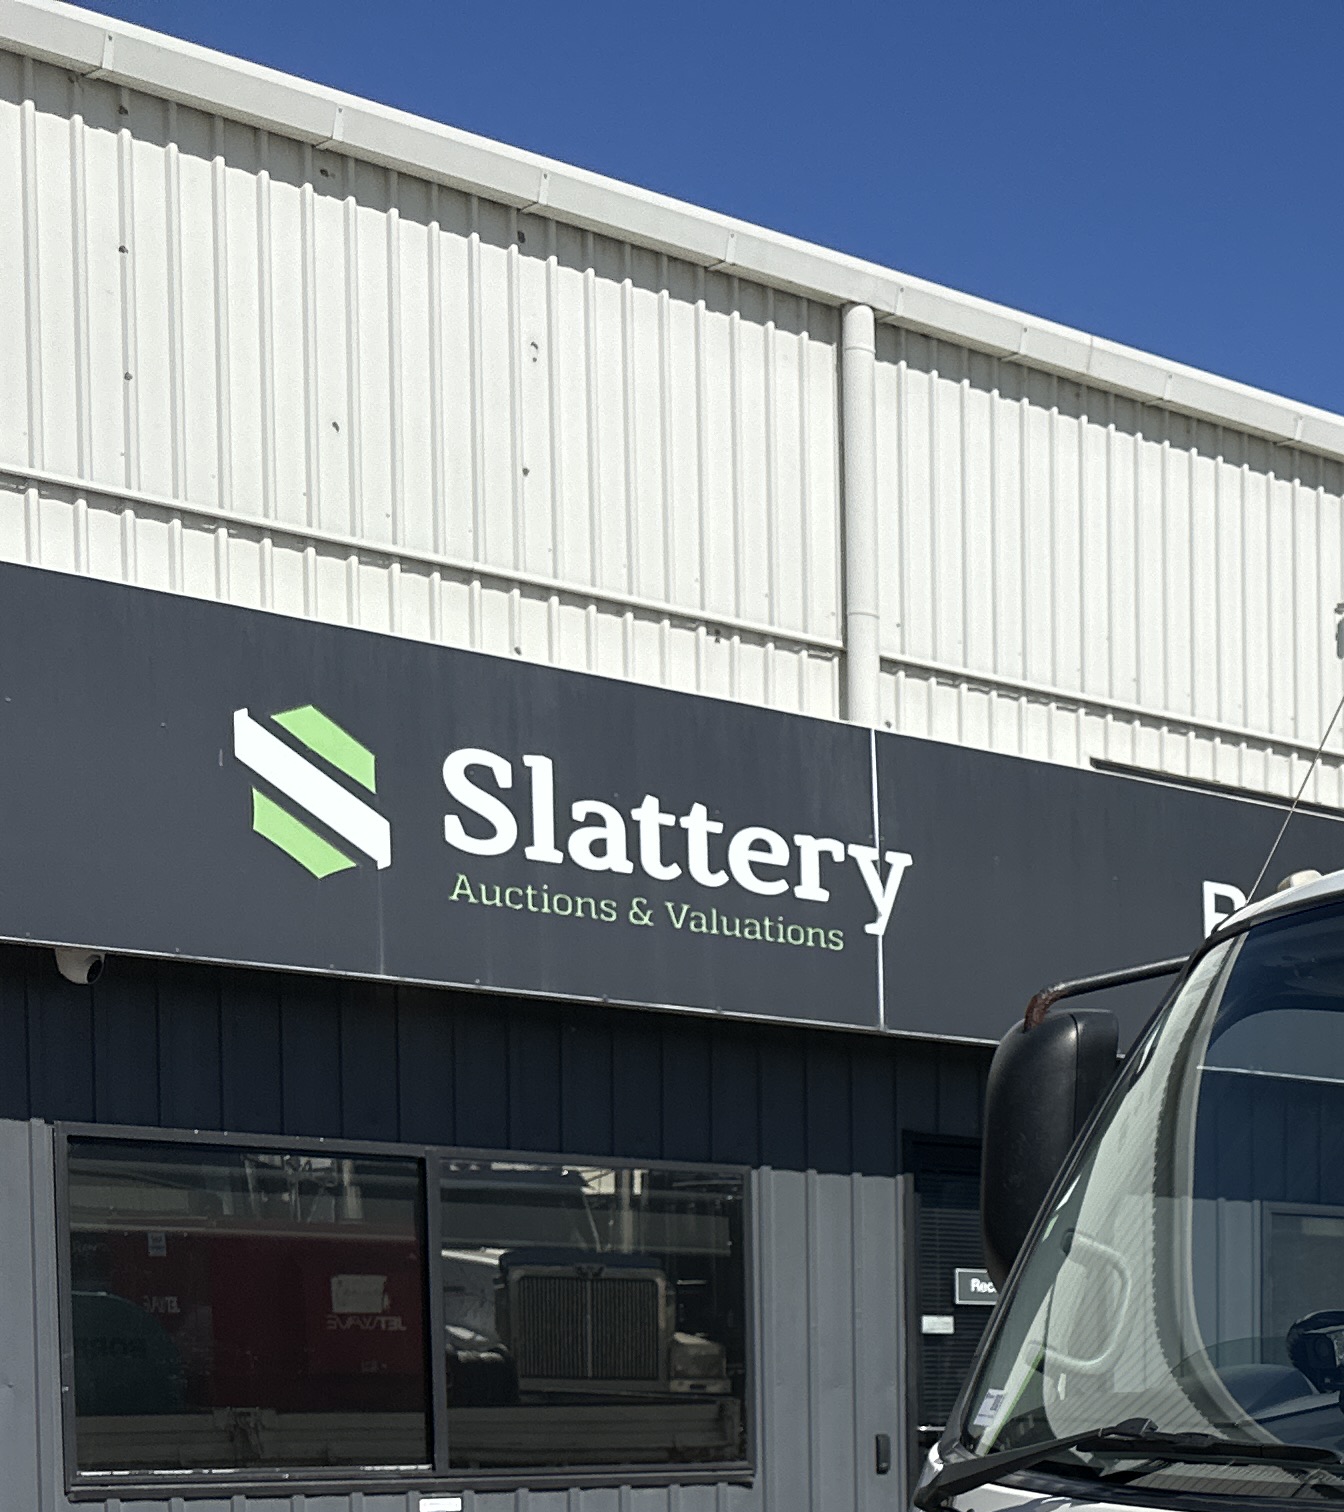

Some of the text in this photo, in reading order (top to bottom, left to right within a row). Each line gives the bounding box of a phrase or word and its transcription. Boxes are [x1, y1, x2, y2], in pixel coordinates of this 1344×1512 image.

[442, 748, 913, 935] Slattery
[449, 873, 845, 951] Auctions & Valuations
